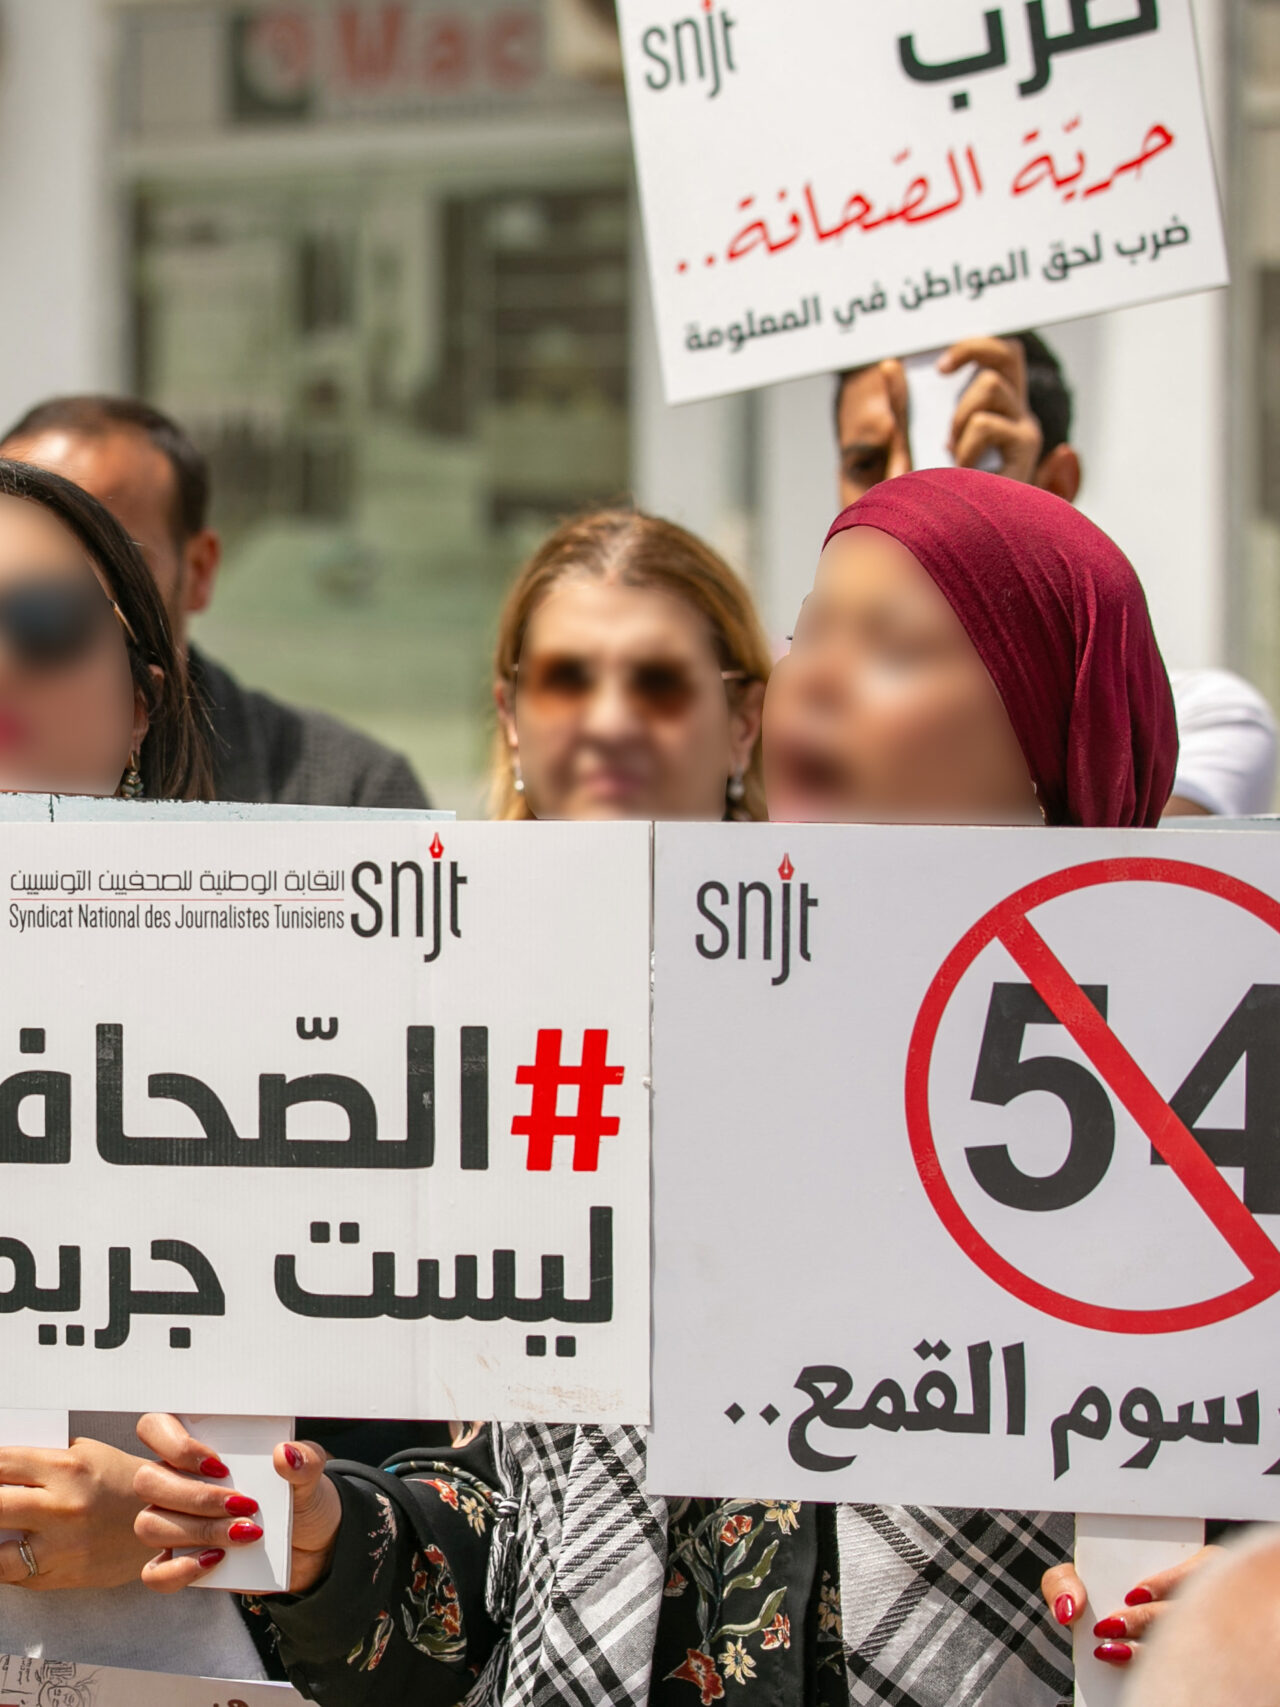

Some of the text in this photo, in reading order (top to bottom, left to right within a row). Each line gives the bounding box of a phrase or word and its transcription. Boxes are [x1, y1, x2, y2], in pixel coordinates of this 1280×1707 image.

[642, 0, 737, 98] snjt
[684, 216, 1191, 356] ضرب لحق المواطن في المعلومة
[9, 904, 345, 933] Syndicat National des Journalistes Tunisiens
[10, 869, 345, 896] النقابة الوطنية للصحفيين التونسيين
[351, 832, 467, 963] snjt
[695, 853, 818, 986] snjt
[964, 982, 1280, 1215] 54
[274, 1205, 614, 1357] ليست
[724, 1339, 1280, 1481] سوم القمع..
